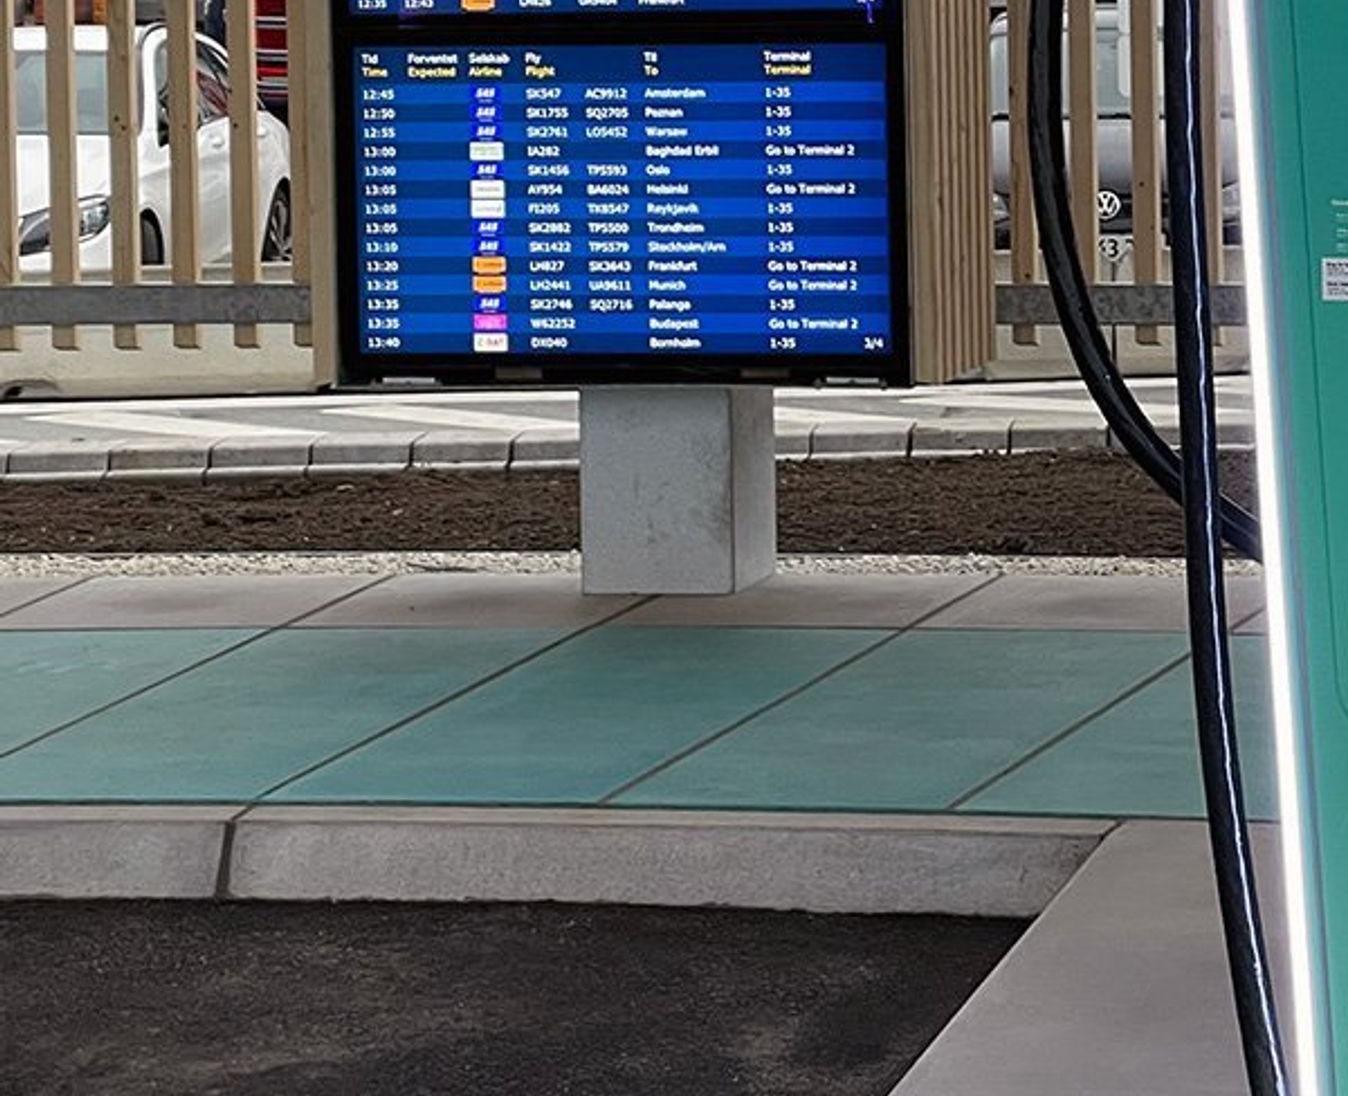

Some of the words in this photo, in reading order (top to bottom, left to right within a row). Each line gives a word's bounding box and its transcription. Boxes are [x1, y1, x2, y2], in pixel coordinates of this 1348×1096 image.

[361, 54, 378, 64] Tid
[525, 52, 541, 65] Fly
[763, 50, 811, 62] Terminal
[362, 67, 388, 77] Time
[407, 66, 456, 79] Expected
[468, 66, 502, 77] Airline
[525, 66, 555, 79] Flight
[644, 65, 659, 76] To
[764, 64, 811, 75] Terminal
[645, 88, 706, 98] Amsterdam
[766, 87, 791, 97] 1-35
[645, 107, 683, 117] Poznan
[766, 106, 791, 117] 1-35
[645, 127, 687, 136] Warsaw
[767, 126, 791, 136] 1-35
[646, 146, 692, 158] Baghdad
[766, 145, 782, 156] Go
[784, 146, 796, 155] to
[798, 144, 845, 155] Terminal
[847, 144, 854, 155] 2
[646, 165, 670, 175] Oslo
[768, 164, 792, 175] 1-35
[647, 184, 688, 194] Helsinki
[766, 183, 782, 194] Go
[784, 185, 797, 194] to
[798, 183, 845, 194] Terminal
[848, 183, 855, 194] 2
[647, 203, 698, 216] Reykjavik
[769, 203, 793, 213] 1-35
[648, 222, 704, 233] Trondheim
[769, 222, 793, 232] 1-35
[769, 241, 794, 252] 1-35
[648, 261, 697, 271] Frankfurt
[768, 261, 784, 271] Go
[786, 261, 798, 271] to
[800, 261, 847, 271] Terminal
[850, 261, 857, 271] 2
[649, 281, 686, 290] Munich
[768, 280, 784, 290] Go
[786, 281, 798, 290] to
[801, 280, 847, 290] Terminal
[850, 280, 857, 290] 2
[649, 299, 691, 312] Palanga
[770, 299, 795, 310] 1-35
[650, 318, 699, 330] Budapest
[769, 318, 785, 329] Go
[787, 319, 799, 328] to
[802, 318, 848, 329] Terminal
[851, 319, 858, 329] 2
[650, 337, 701, 348] Bornholm
[771, 338, 796, 348] 1-35
